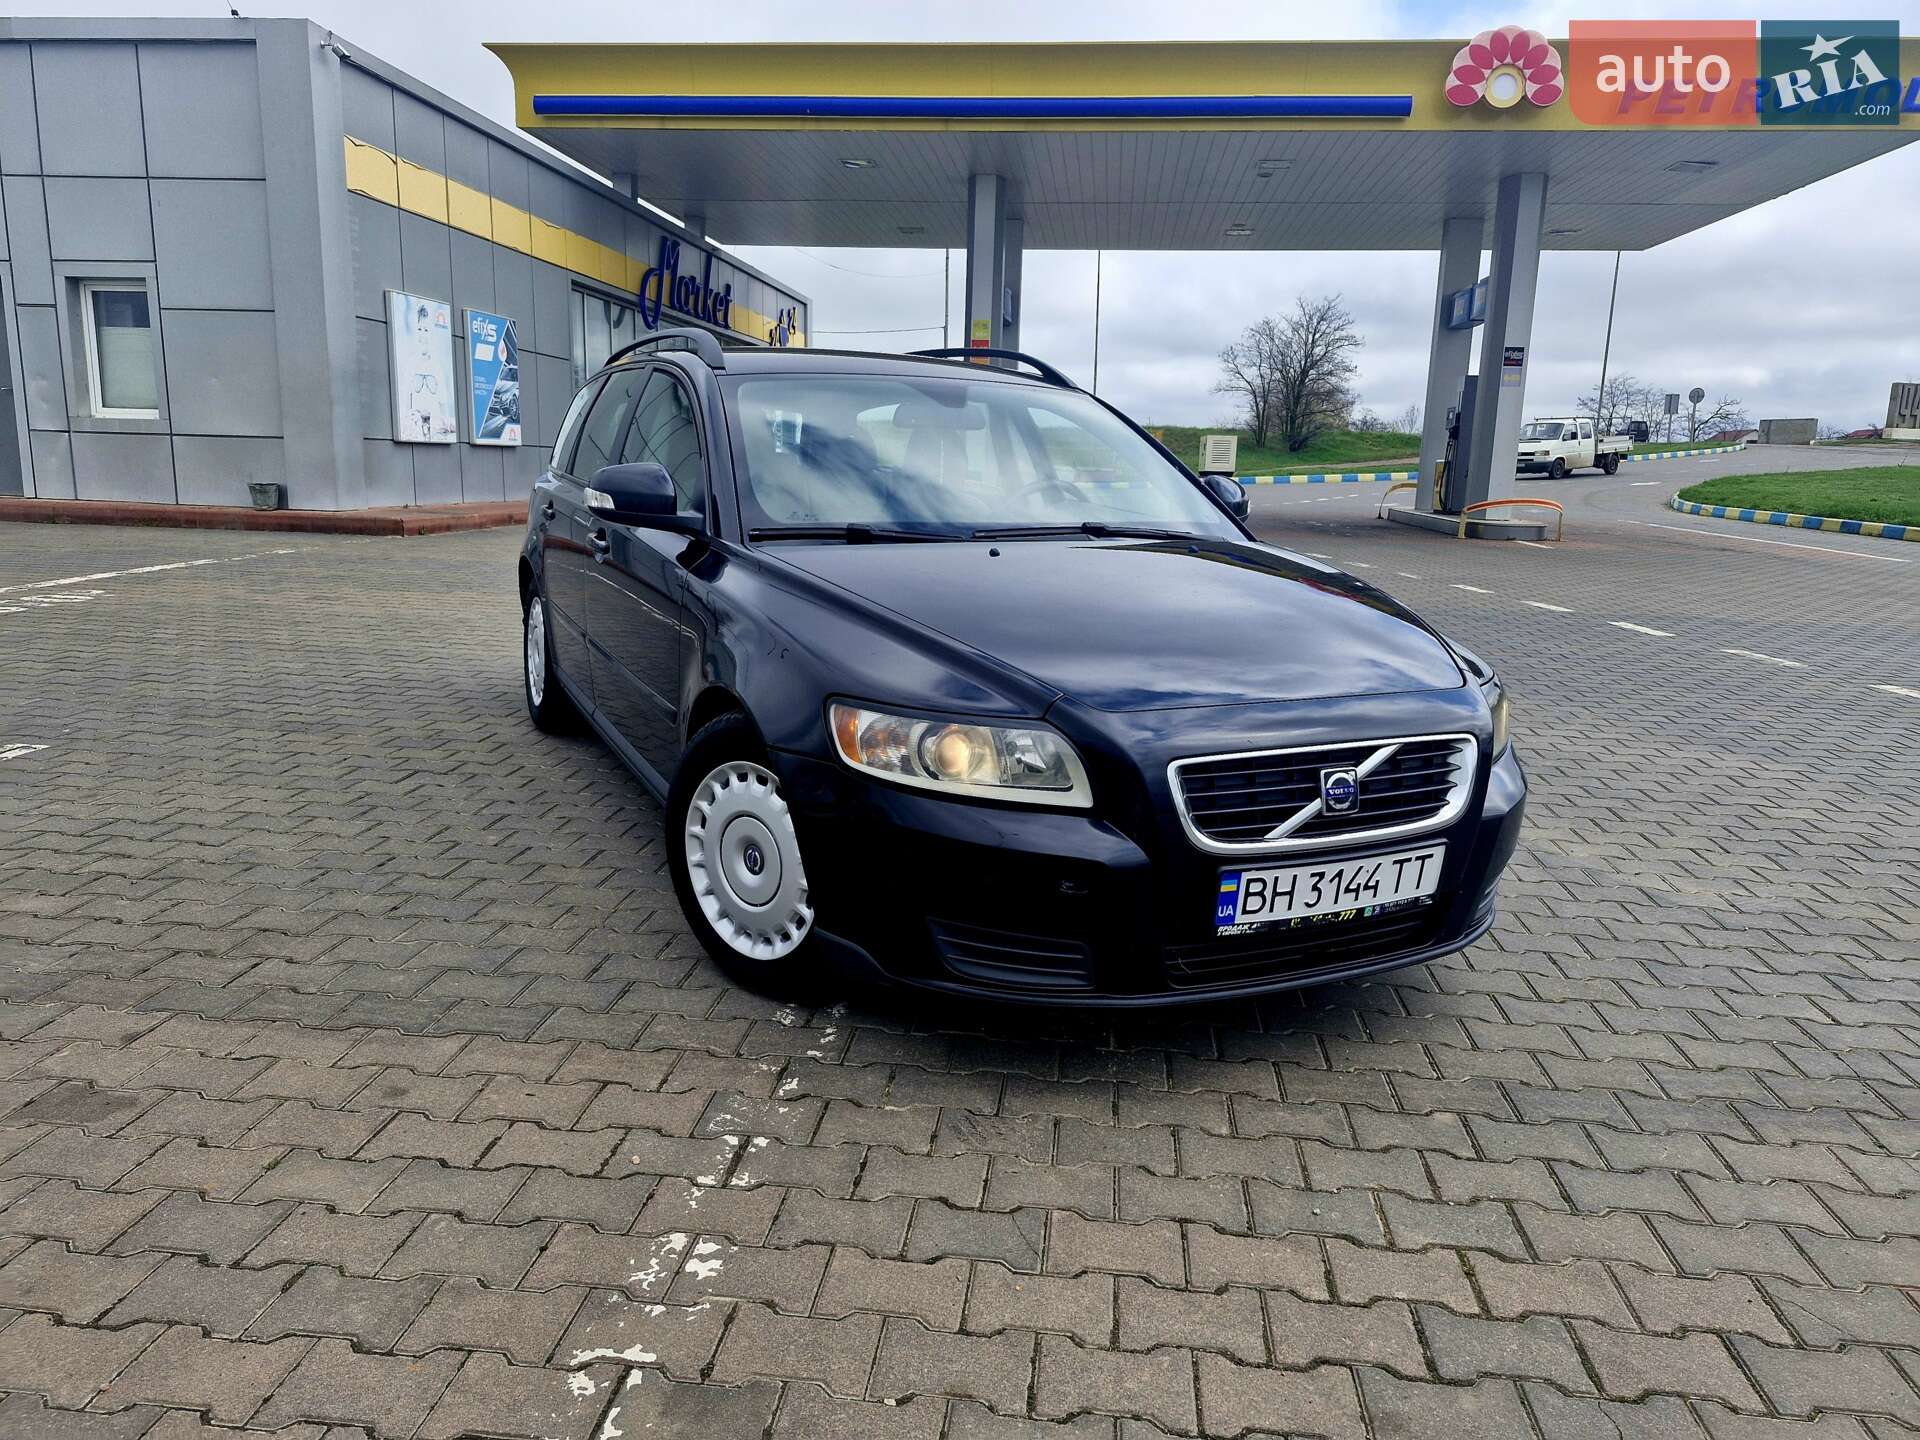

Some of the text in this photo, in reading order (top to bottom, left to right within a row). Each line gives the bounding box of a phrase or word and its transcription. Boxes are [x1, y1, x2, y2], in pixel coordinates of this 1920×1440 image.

[639, 235, 733, 331] Market
[1217, 905, 1235, 917] UA
[1240, 874, 1298, 916] BH
[1303, 862, 1384, 909] 3144
[1392, 853, 1434, 894] TT
